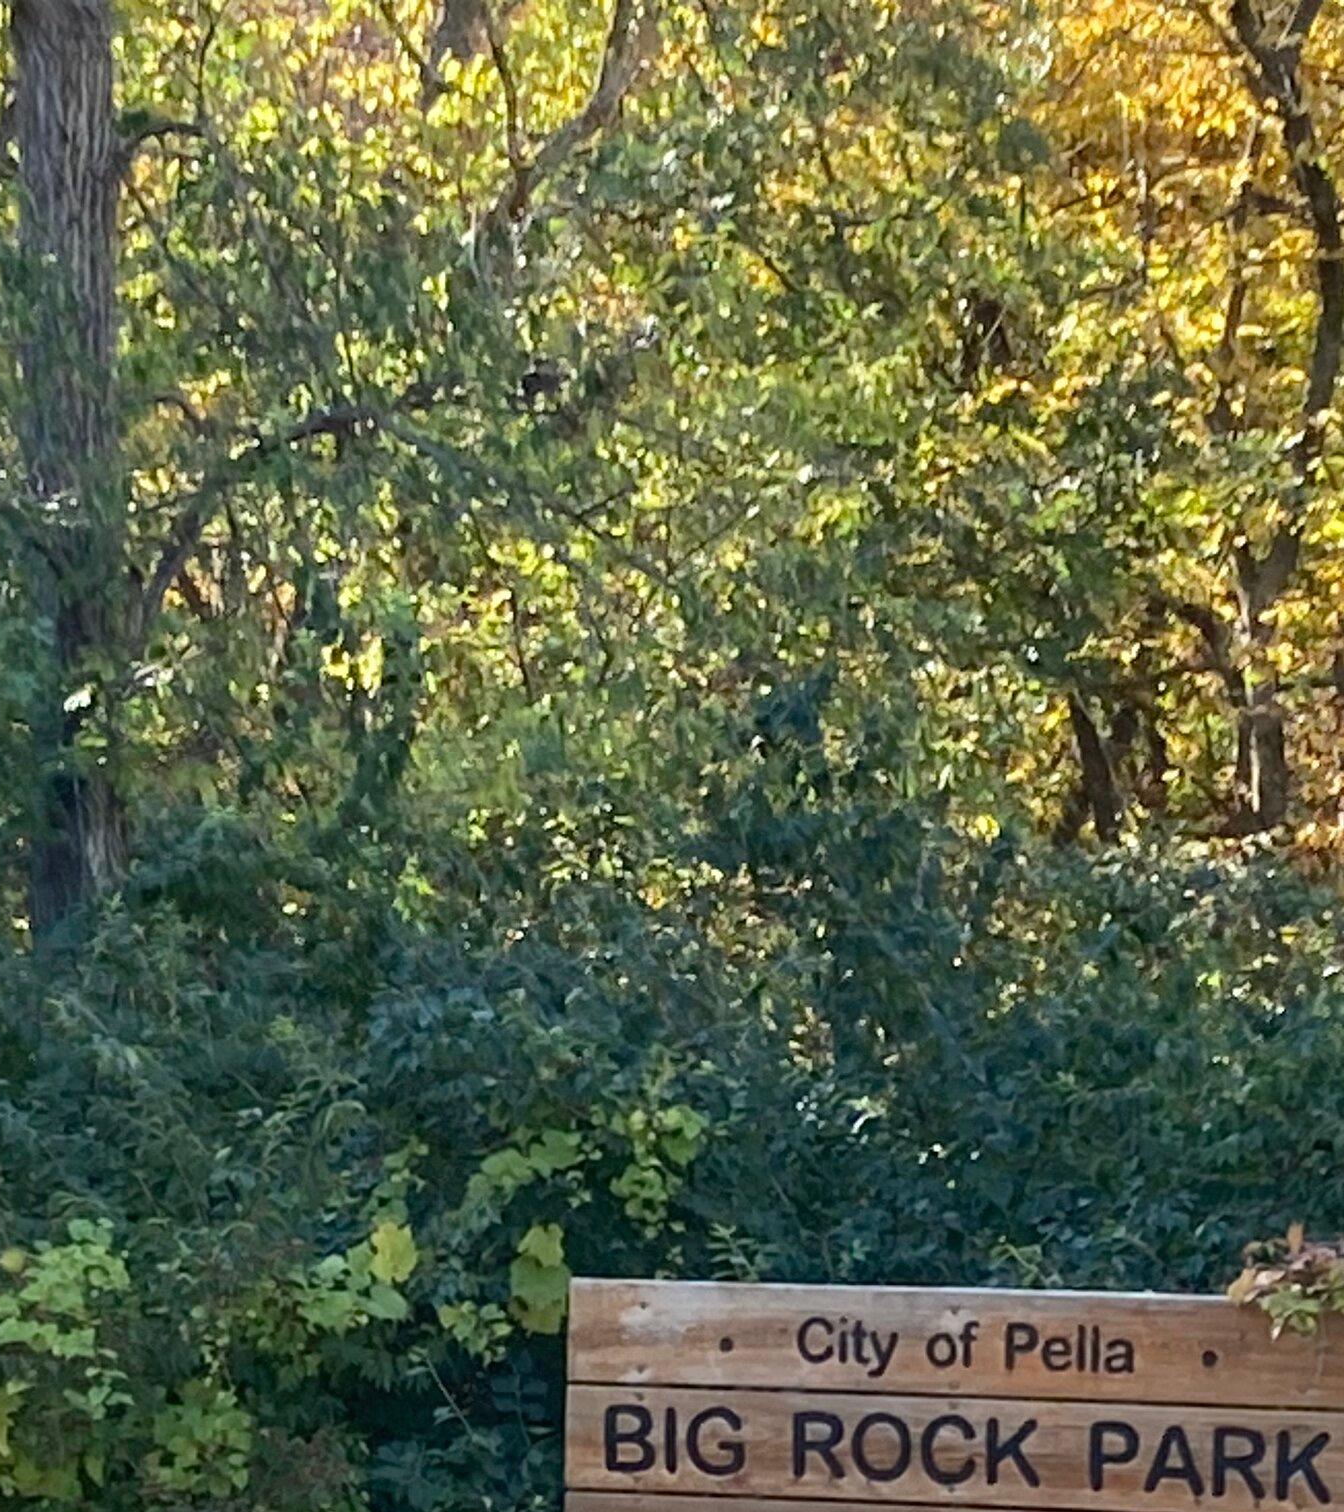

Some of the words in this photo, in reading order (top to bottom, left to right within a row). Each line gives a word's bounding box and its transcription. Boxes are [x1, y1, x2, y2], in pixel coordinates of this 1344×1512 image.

[797, 1315, 899, 1378] City
[925, 1320, 981, 1369] of
[1004, 1321, 1136, 1375] Pella
[604, 1404, 747, 1477] BIG
[792, 1410, 1041, 1488] ROCK
[1088, 1420, 1332, 1505] PARK
